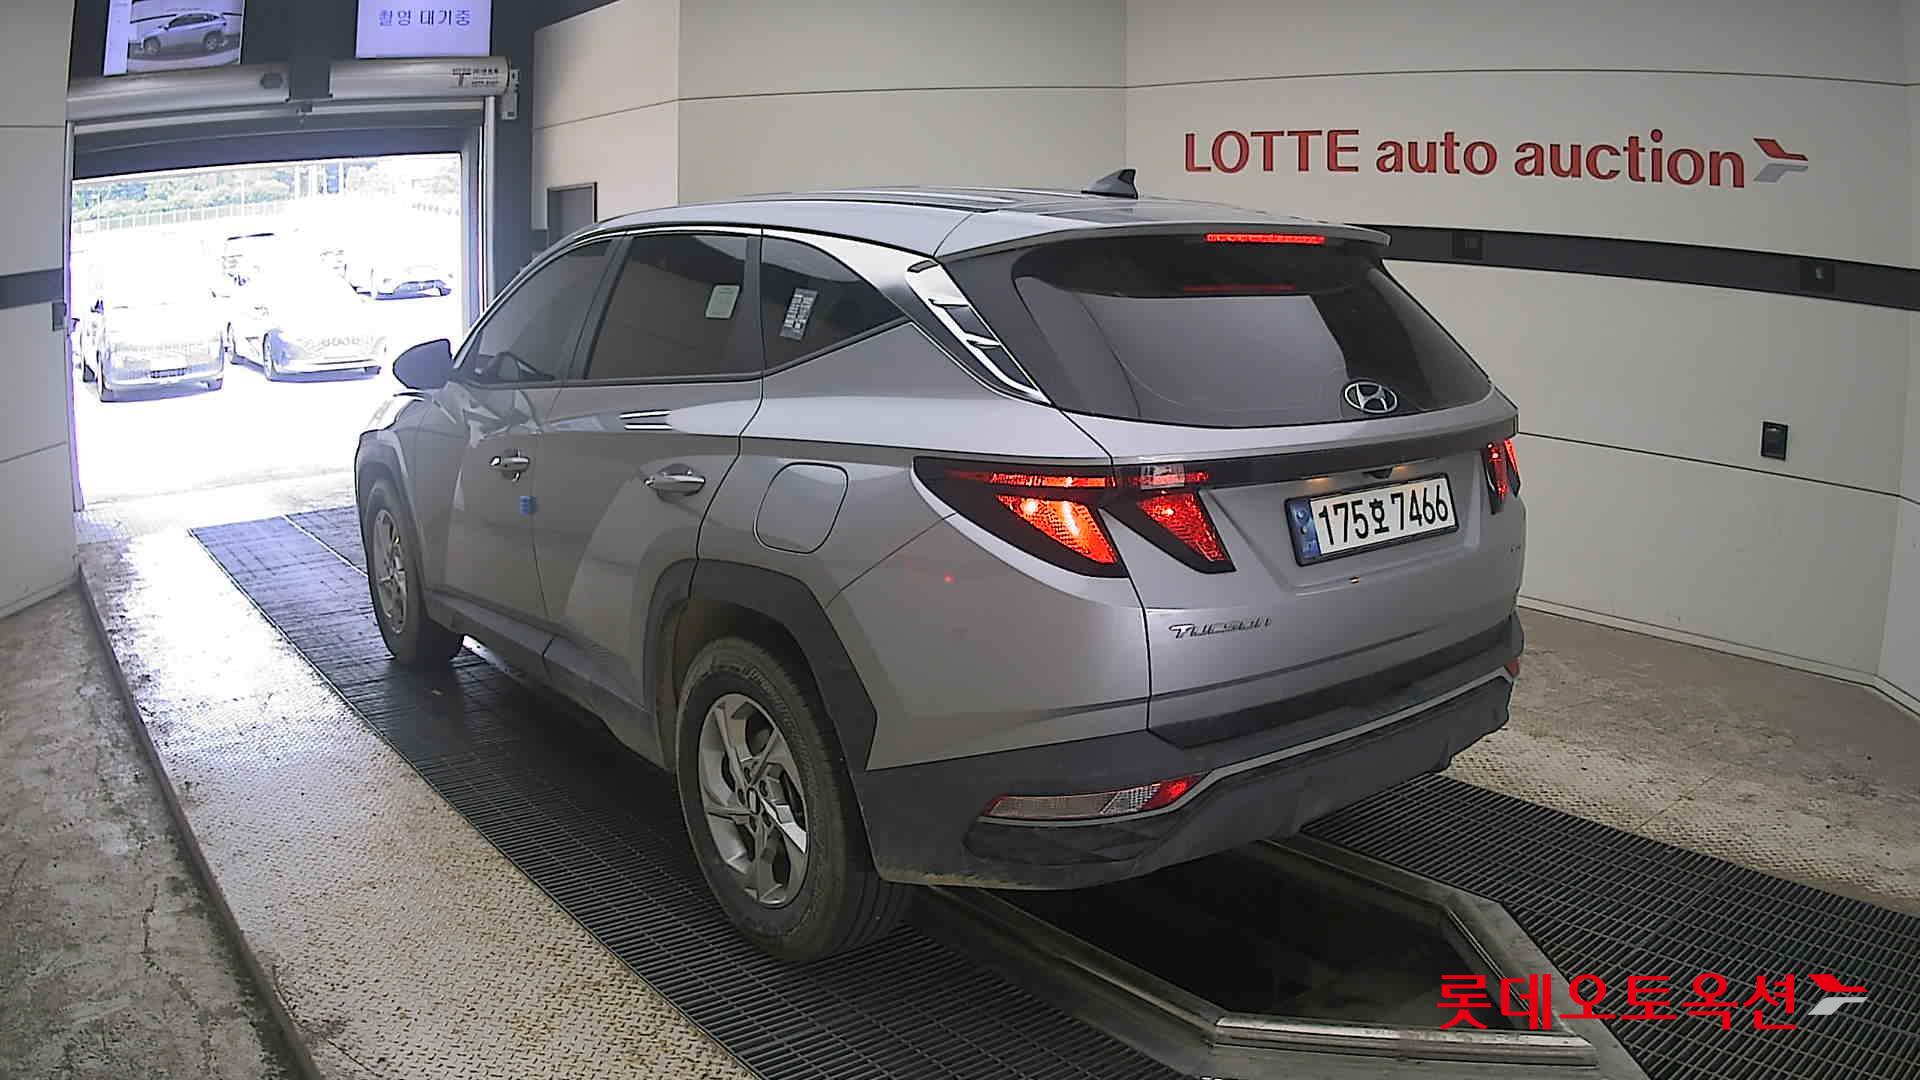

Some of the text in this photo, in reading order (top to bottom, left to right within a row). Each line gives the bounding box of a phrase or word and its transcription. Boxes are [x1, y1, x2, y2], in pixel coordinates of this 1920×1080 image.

[420, 9, 471, 26] 대기중
[1185, 128, 1745, 189] LOTTE auto auction
[1318, 484, 1449, 545] 175호 7466
